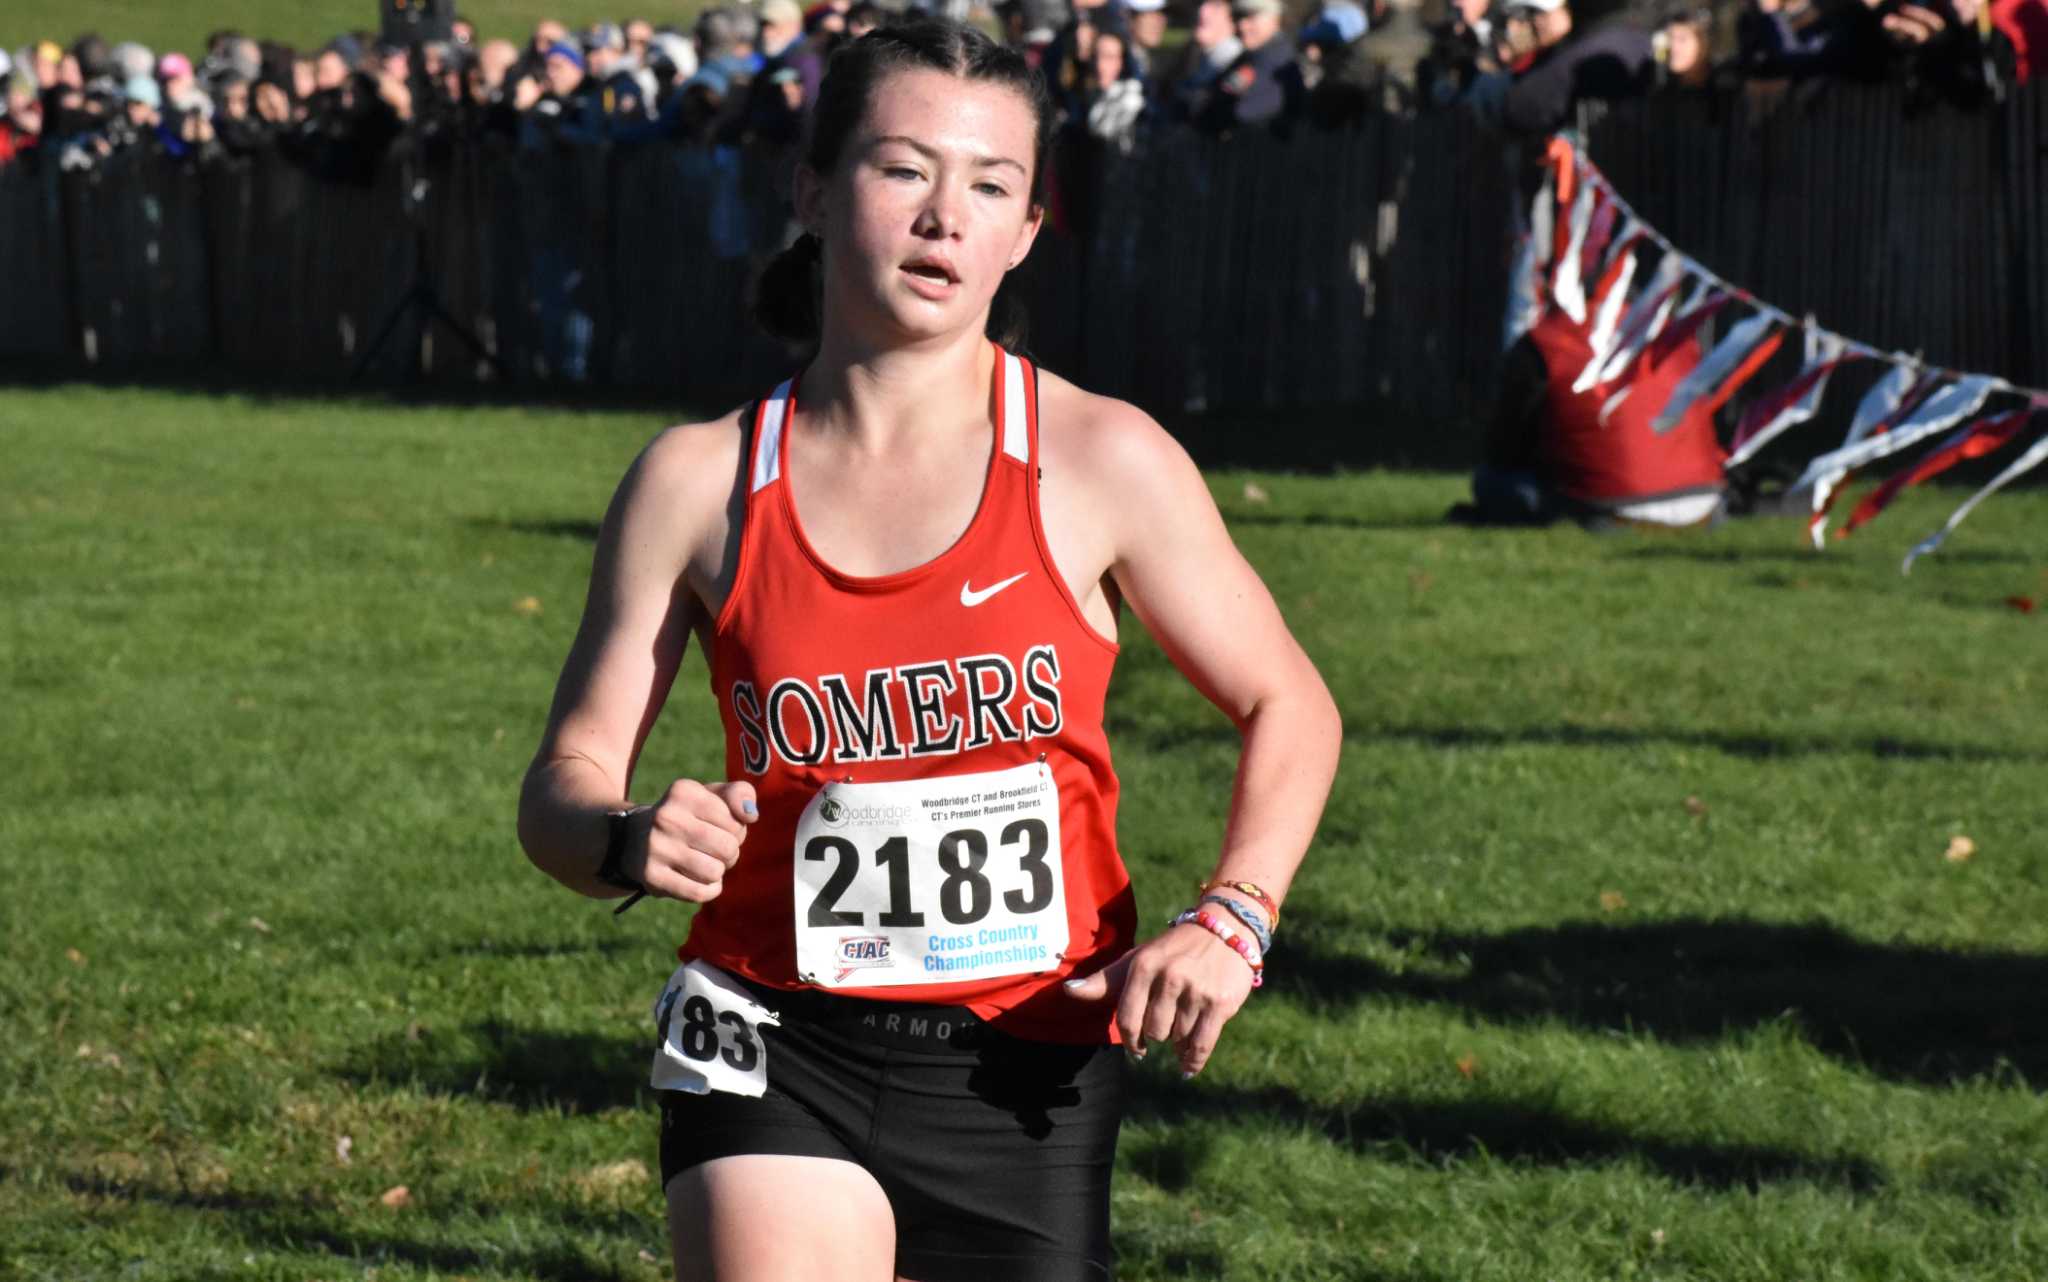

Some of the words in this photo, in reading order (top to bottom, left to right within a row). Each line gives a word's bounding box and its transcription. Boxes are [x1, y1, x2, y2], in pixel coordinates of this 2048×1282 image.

[732, 644, 1063, 775] SOMERS
[921, 797, 969, 808] Woodbridge
[971, 793, 981, 803] CT
[983, 792, 997, 802] and
[1000, 784, 1038, 799] Brookfield
[931, 811, 948, 821] CT's
[950, 808, 981, 819] Premier
[983, 803, 1015, 815] Running
[1017, 799, 1041, 810] Stores
[804, 818, 1054, 928] 2183
[844, 941, 890, 959] CIAC
[928, 934, 974, 951] Cross
[978, 924, 1038, 945] Country
[924, 944, 1047, 971] Championships
[863, 1013, 974, 1040] ARMO
